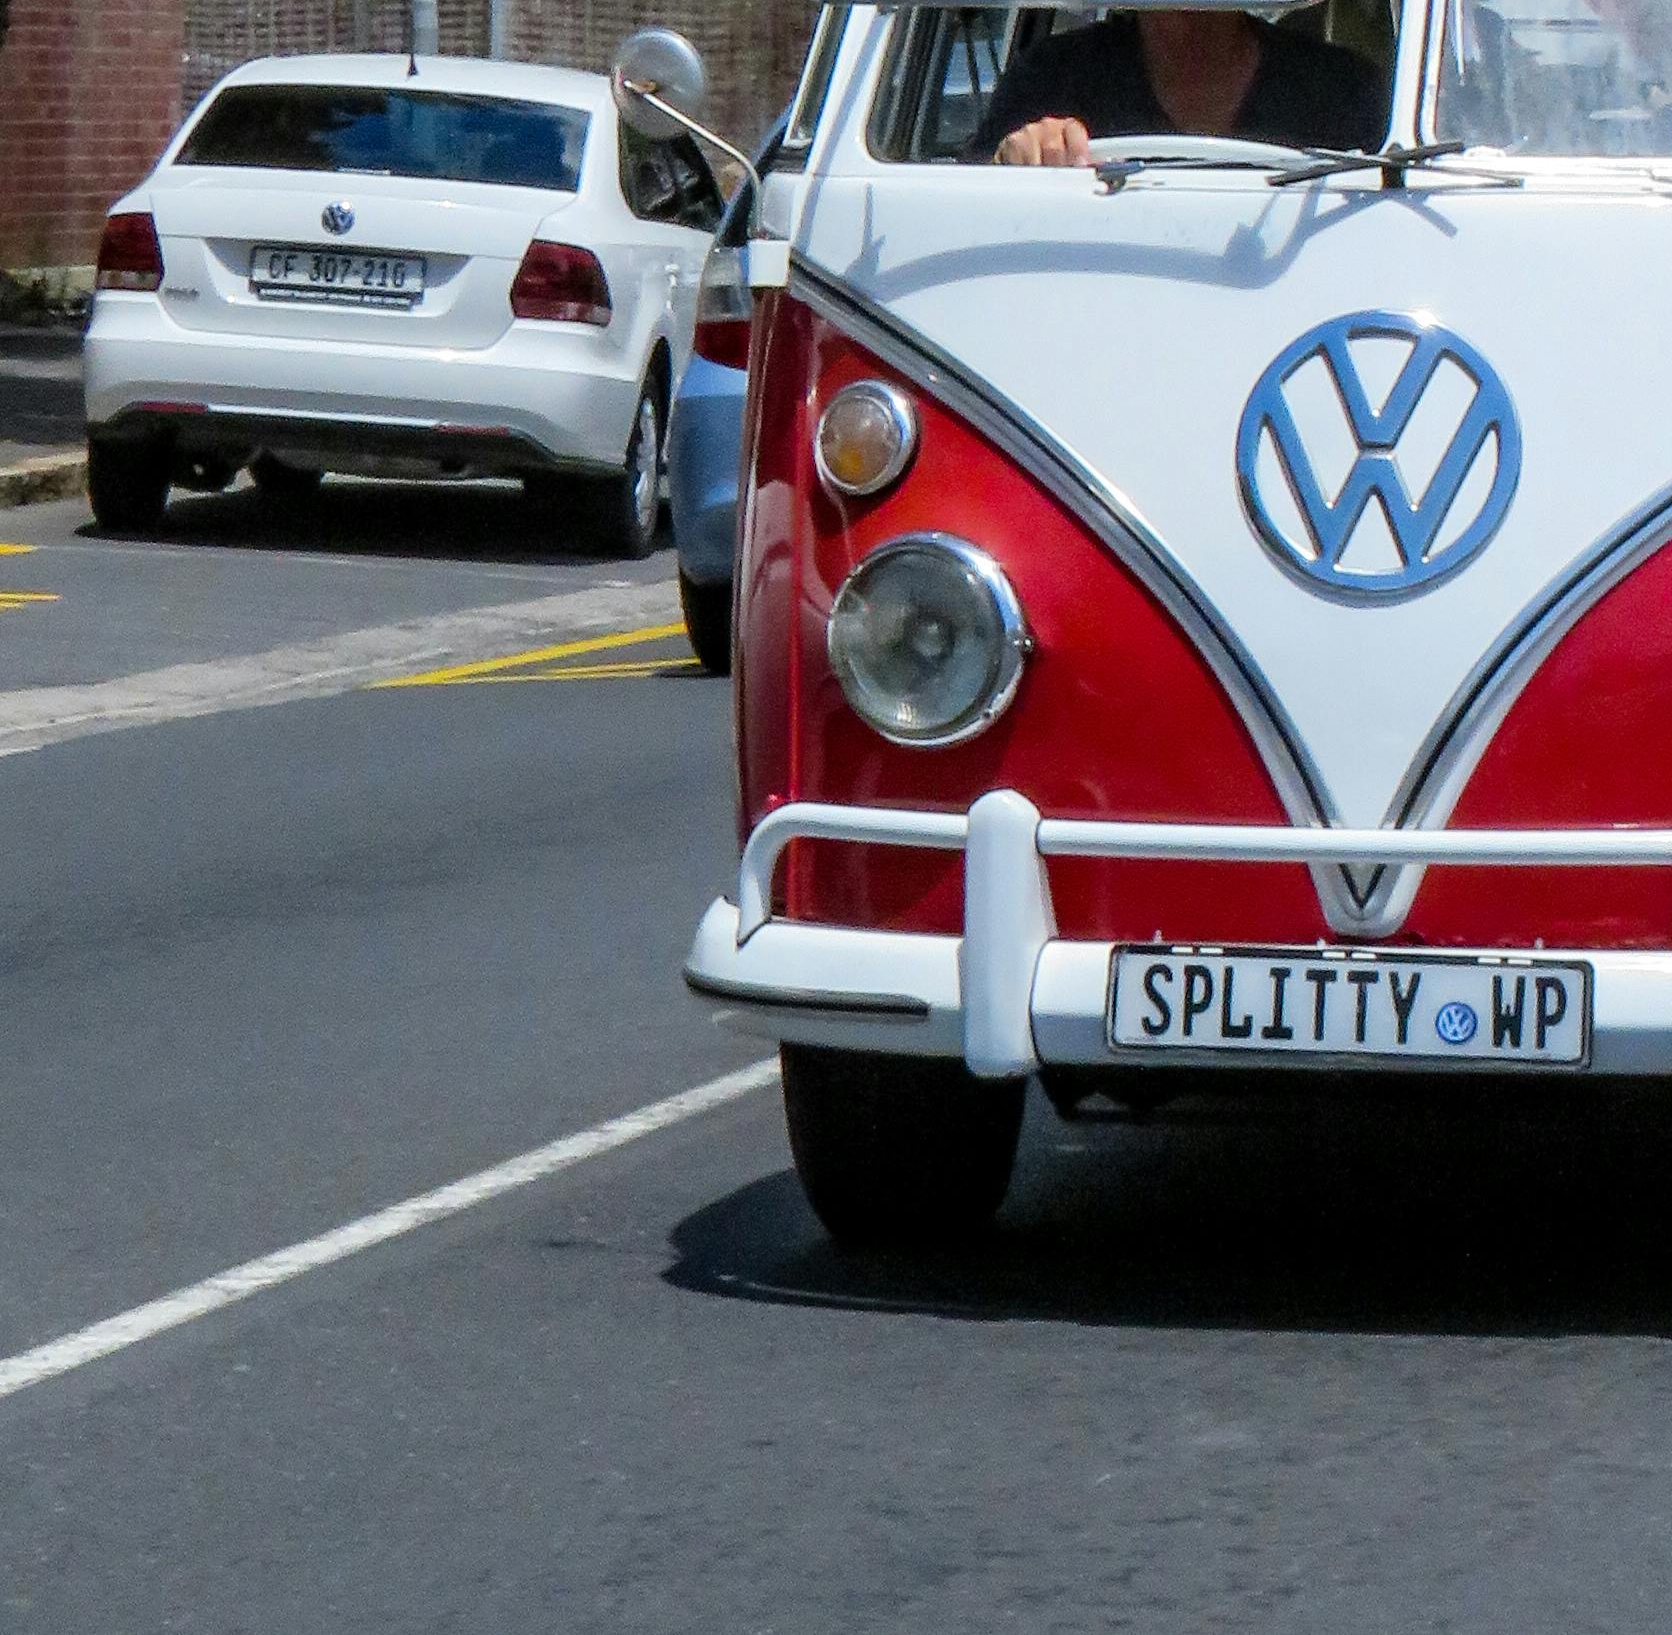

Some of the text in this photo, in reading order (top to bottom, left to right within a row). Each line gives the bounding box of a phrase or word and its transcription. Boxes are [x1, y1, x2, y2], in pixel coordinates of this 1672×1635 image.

[269, 252, 298, 280] CF
[1236, 310, 1522, 607] VW
[1140, 963, 1422, 1045] SPLITTY
[1491, 975, 1568, 1050] WP
